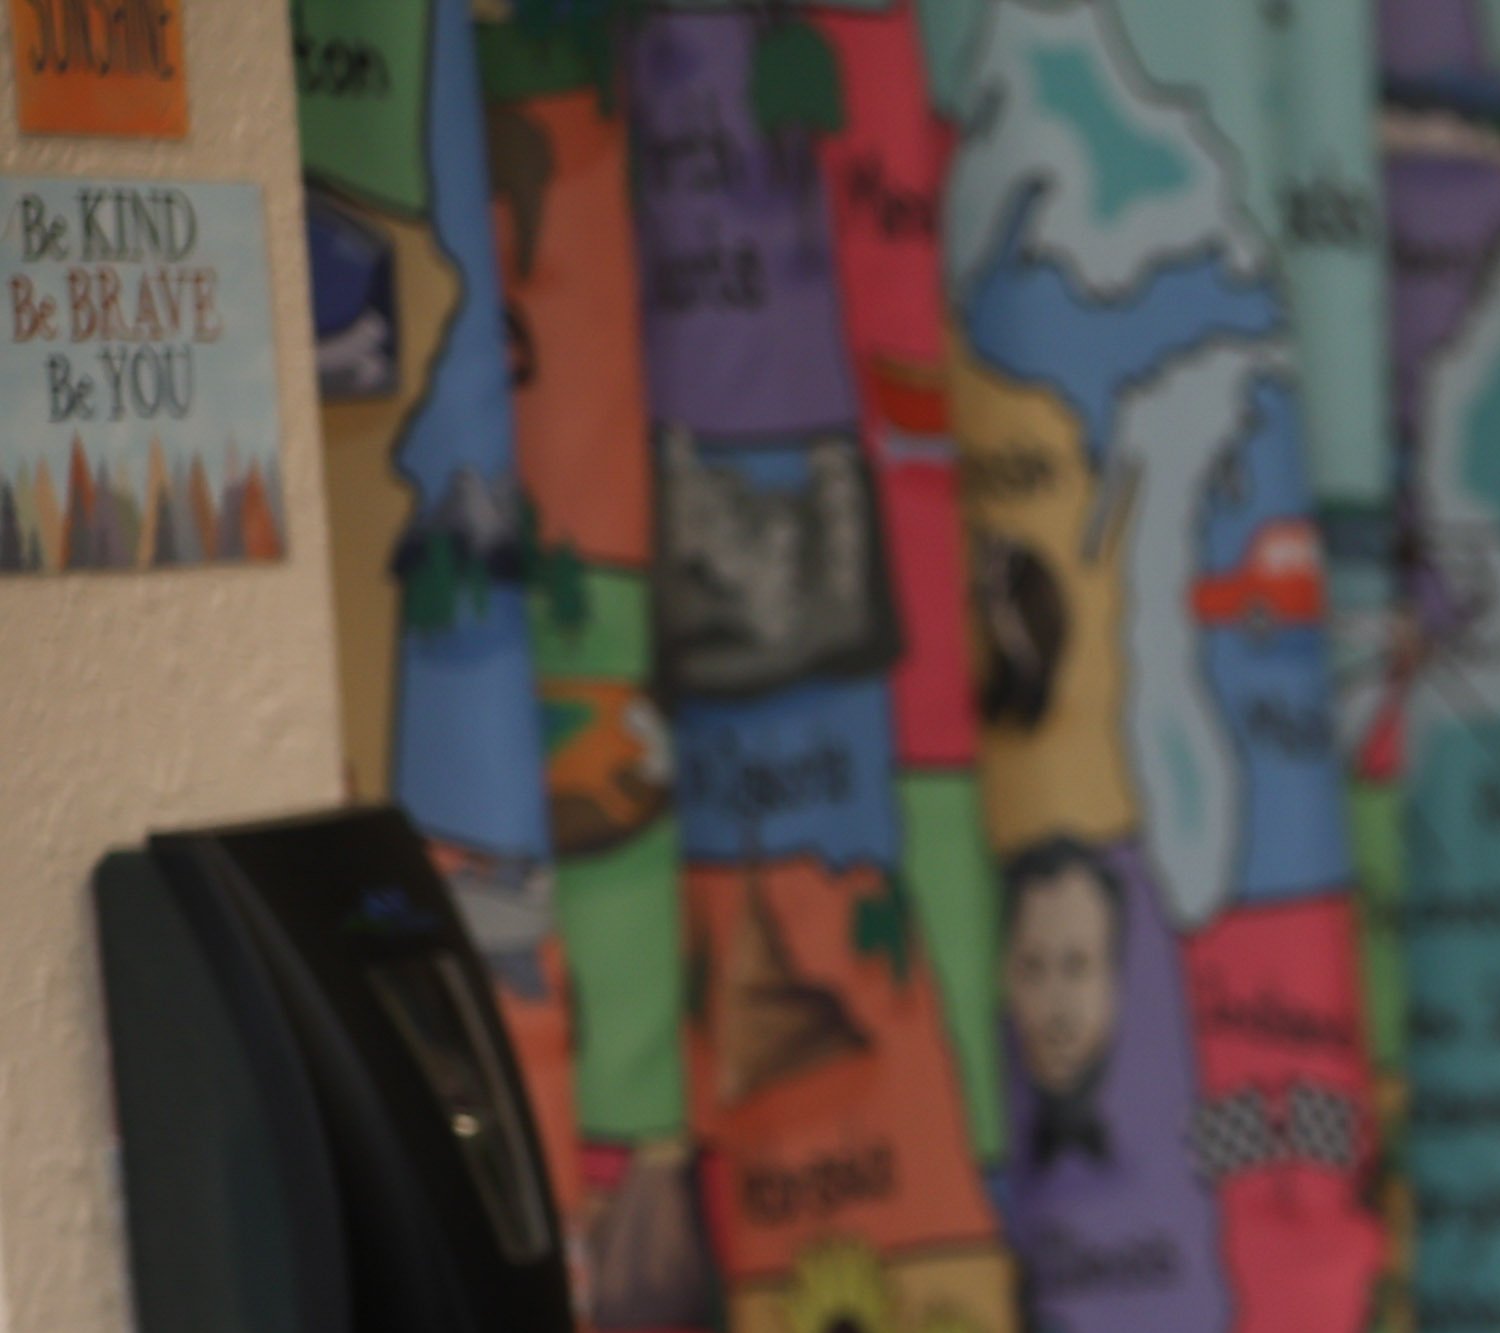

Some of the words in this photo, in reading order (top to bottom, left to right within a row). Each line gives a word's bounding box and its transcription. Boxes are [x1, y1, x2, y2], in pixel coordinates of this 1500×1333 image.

[21, 193, 70, 262] Be
[78, 187, 198, 262] KIND
[12, 273, 58, 343] Be
[67, 265, 223, 343] BRAVE
[47, 354, 95, 423] Be
[100, 345, 193, 421] YOU
